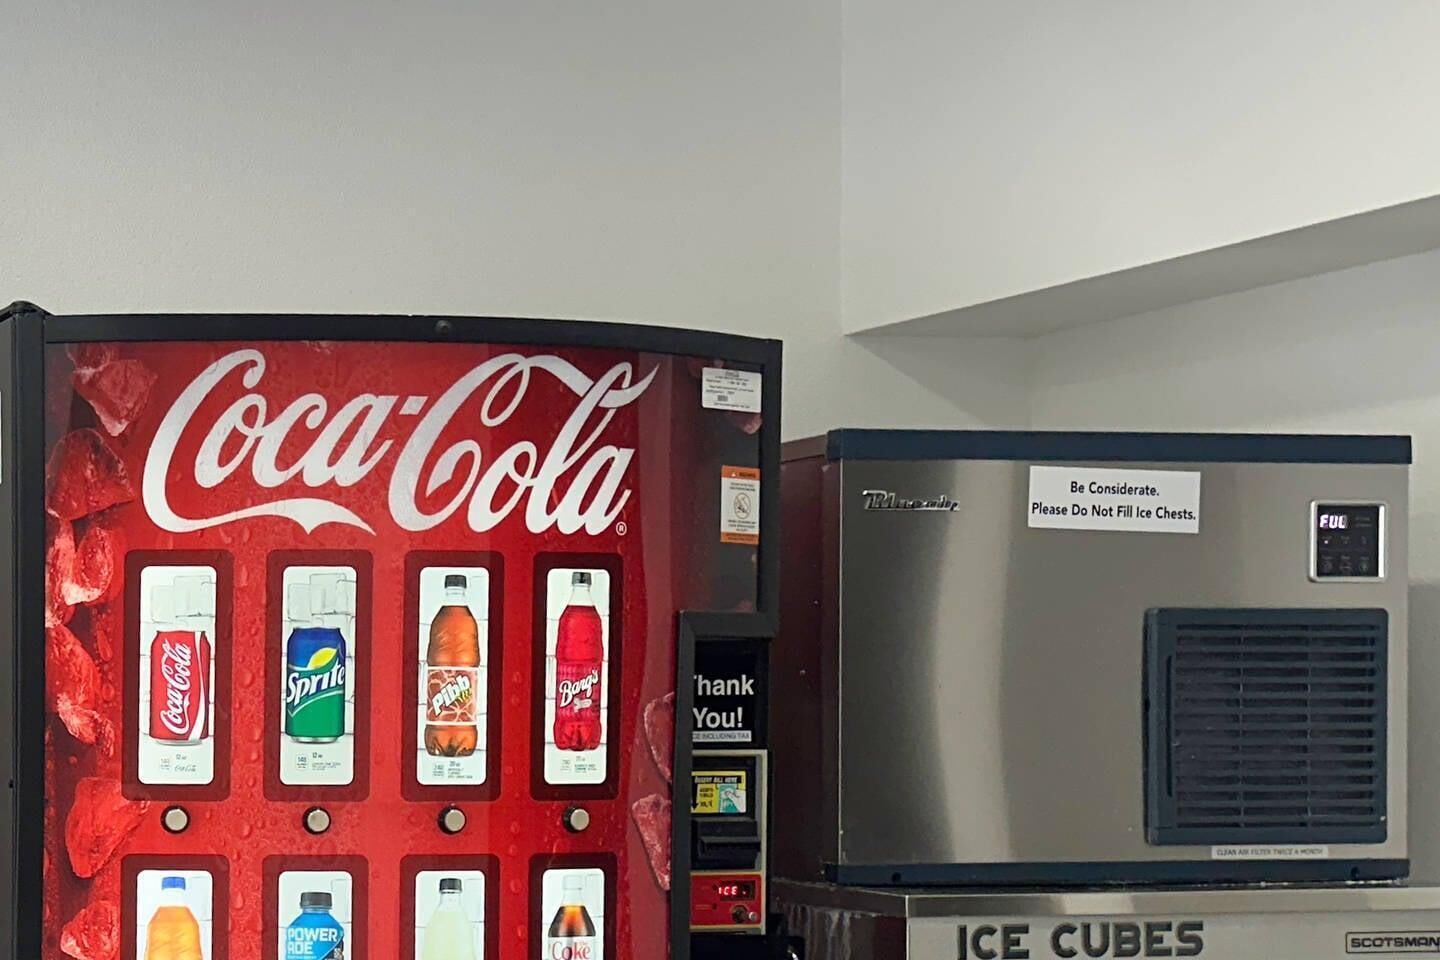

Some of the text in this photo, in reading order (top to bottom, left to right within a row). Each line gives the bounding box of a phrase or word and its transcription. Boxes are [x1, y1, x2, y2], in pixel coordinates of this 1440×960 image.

[142, 348, 659, 536] Coca-Cola
[1070, 481, 1160, 497] Be Considerate.
[1031, 502, 1197, 520] Please Do Not Fill Ice Chests.
[286, 657, 345, 705] Sprite
[558, 669, 599, 708] Barq's
[694, 674, 755, 696] hank
[432, 673, 471, 716] Pibb
[692, 706, 743, 729] You!
[287, 927, 338, 942] POWER
[956, 920, 1204, 960] ICE CUBES
[1350, 936, 1440, 948] SCOTSMAN
[552, 940, 592, 960] Coke
